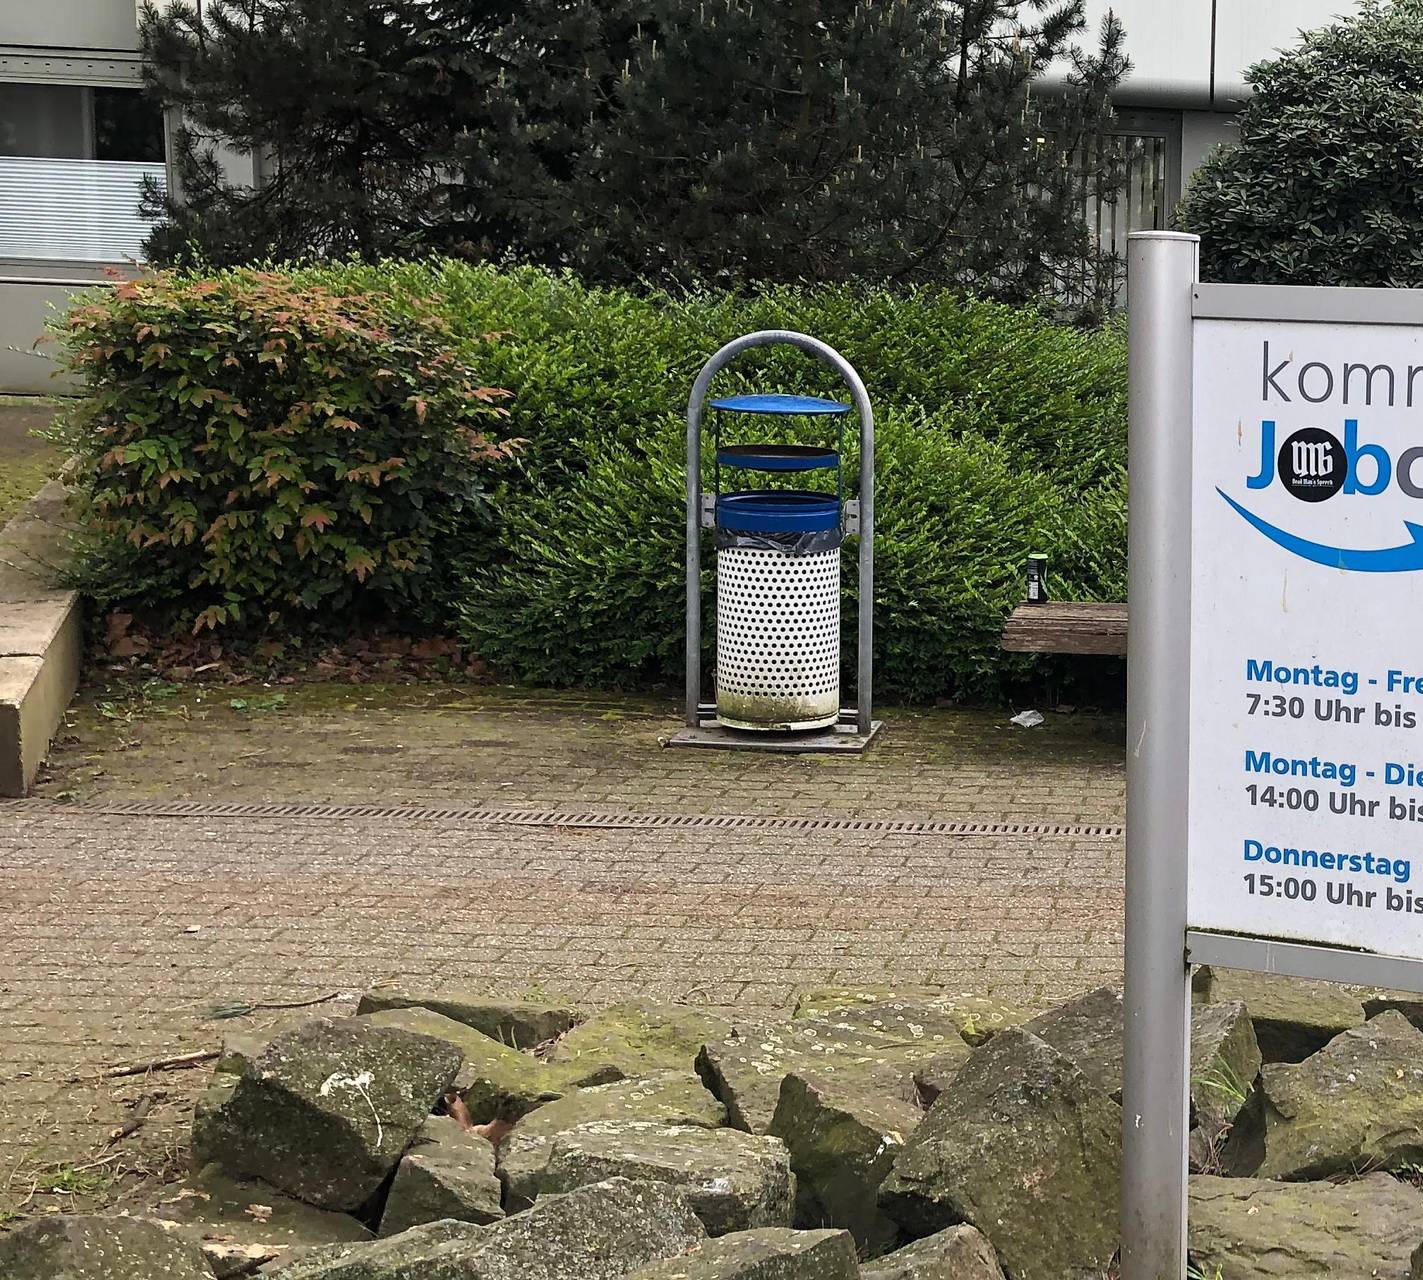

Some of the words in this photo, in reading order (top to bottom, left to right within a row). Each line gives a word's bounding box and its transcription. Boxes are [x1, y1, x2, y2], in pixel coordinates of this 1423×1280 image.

[1246, 658, 1359, 696] Montag
[1246, 692, 1305, 719] 7:30
[1314, 698, 1366, 724] Uhr
[1374, 702, 1417, 729] bis
[1244, 750, 1357, 788] Montag
[1245, 784, 1320, 812] 14:00
[1329, 791, 1381, 818] Uhr
[1243, 839, 1411, 884] Donnerstag
[1243, 873, 1317, 902] 15:00
[1326, 881, 1377, 909] Uhr
